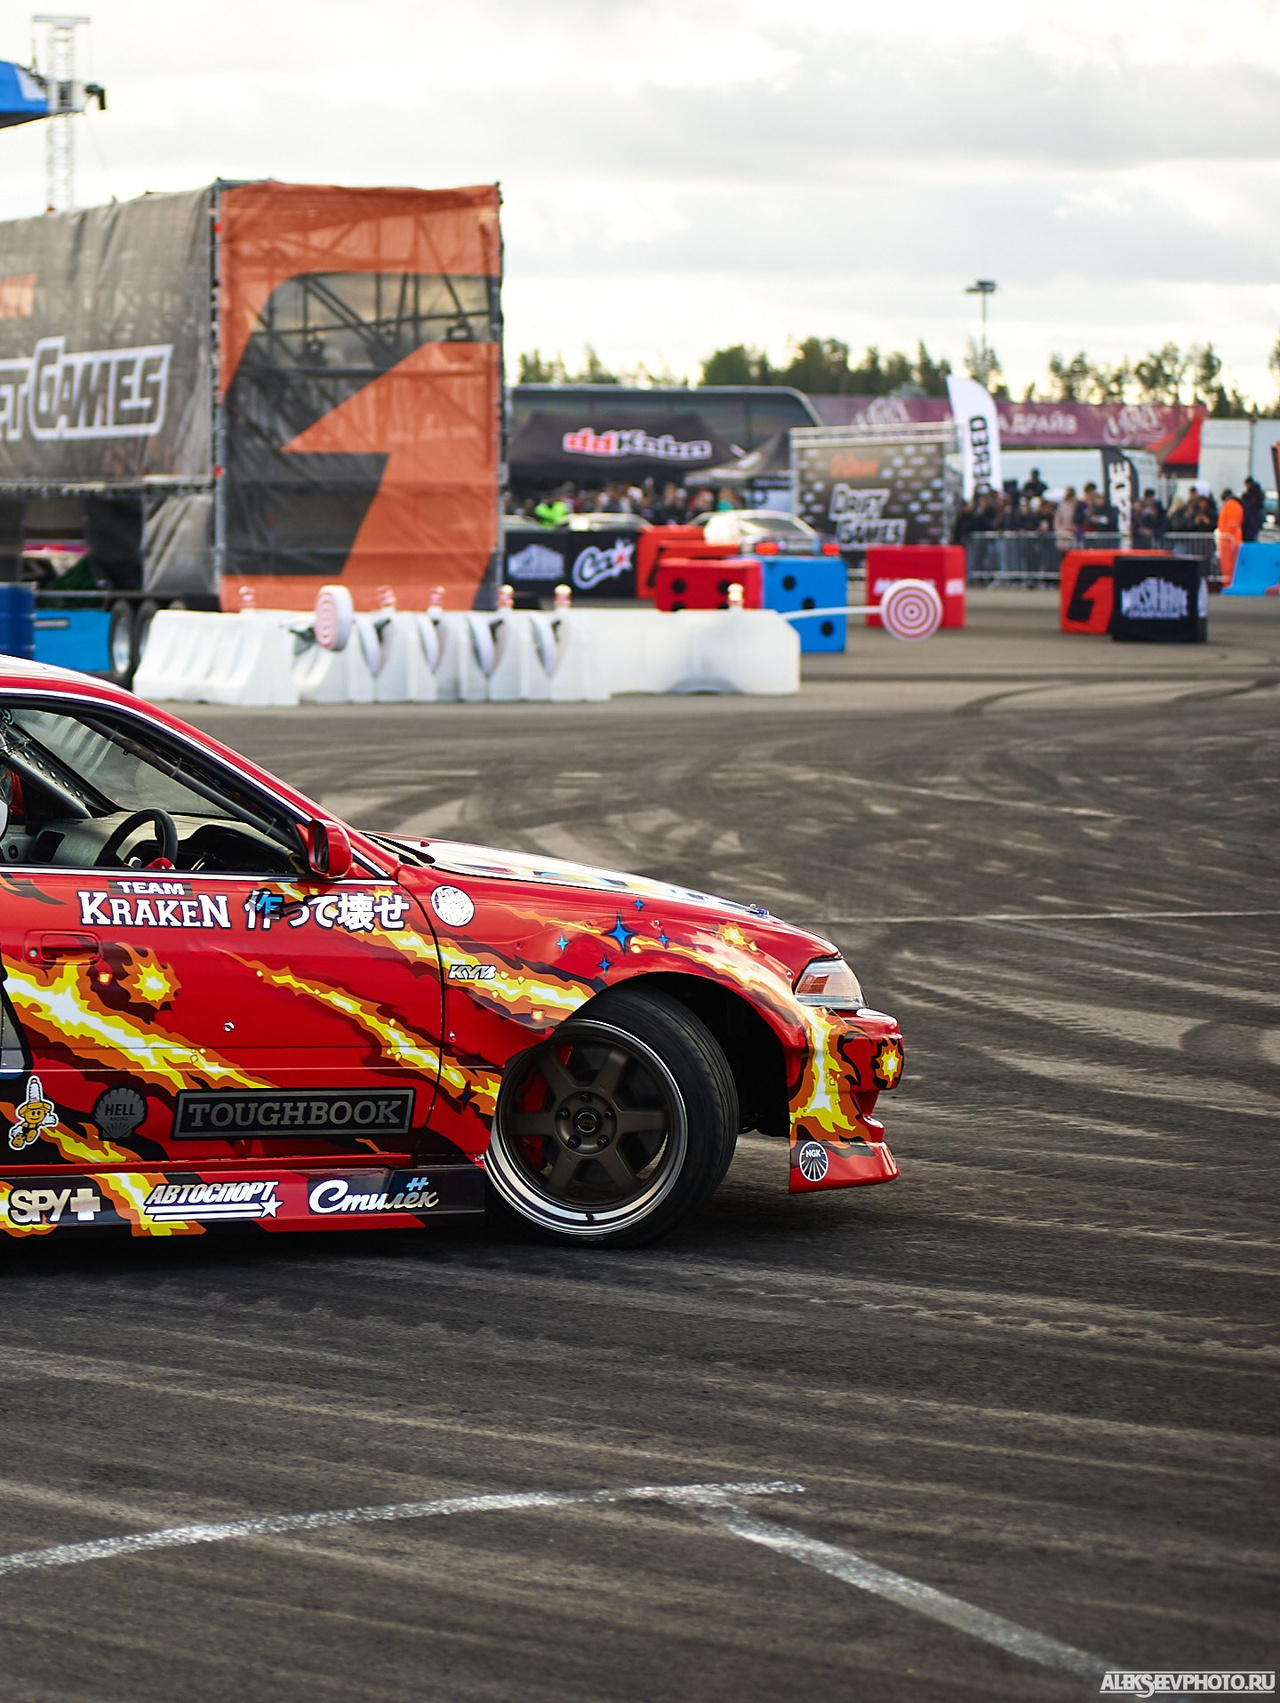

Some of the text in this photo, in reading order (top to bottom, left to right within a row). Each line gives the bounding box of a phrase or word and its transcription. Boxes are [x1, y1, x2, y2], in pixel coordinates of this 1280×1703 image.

[117, 881, 186, 896] TEAM
[78, 890, 232, 929] KRAKEN
[244, 889, 411, 931] 作って壊せ
[448, 964, 497, 980] KYB
[105, 1103, 136, 1116] HELL
[188, 1100, 403, 1127] TOUGHBOOK
[805, 1148, 822, 1158] NGK
[146, 1180, 280, 1206] АВТОСПОРТ
